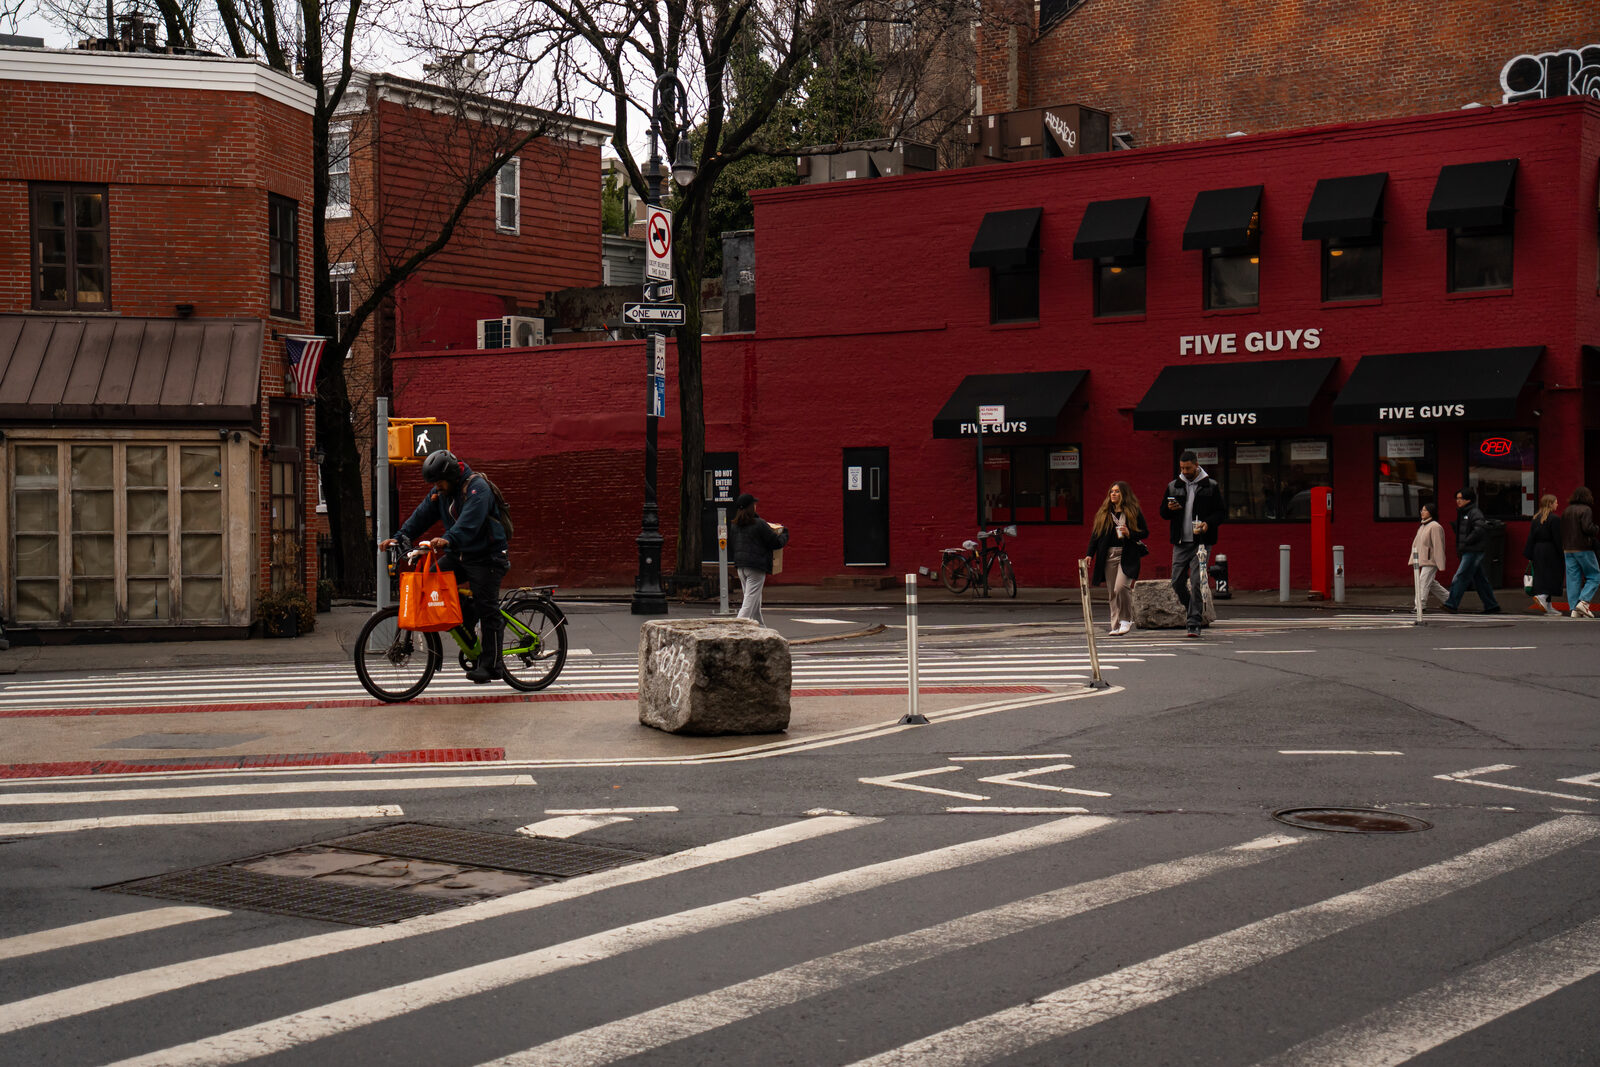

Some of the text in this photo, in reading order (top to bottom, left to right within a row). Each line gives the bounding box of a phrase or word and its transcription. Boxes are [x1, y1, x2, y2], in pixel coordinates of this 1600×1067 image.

[661, 286, 672, 295] WAY
[632, 309, 679, 318] ONE WAY
[1180, 328, 1321, 356] FIVE GUYS
[656, 355, 665, 371] 20
[1379, 404, 1465, 419] FIVE GUYS
[1181, 413, 1257, 426] FIVE GUYS
[960, 421, 1027, 434] FIVE GUYS
[1480, 441, 1512, 453] OPEN
[1216, 580, 1226, 591] 12
